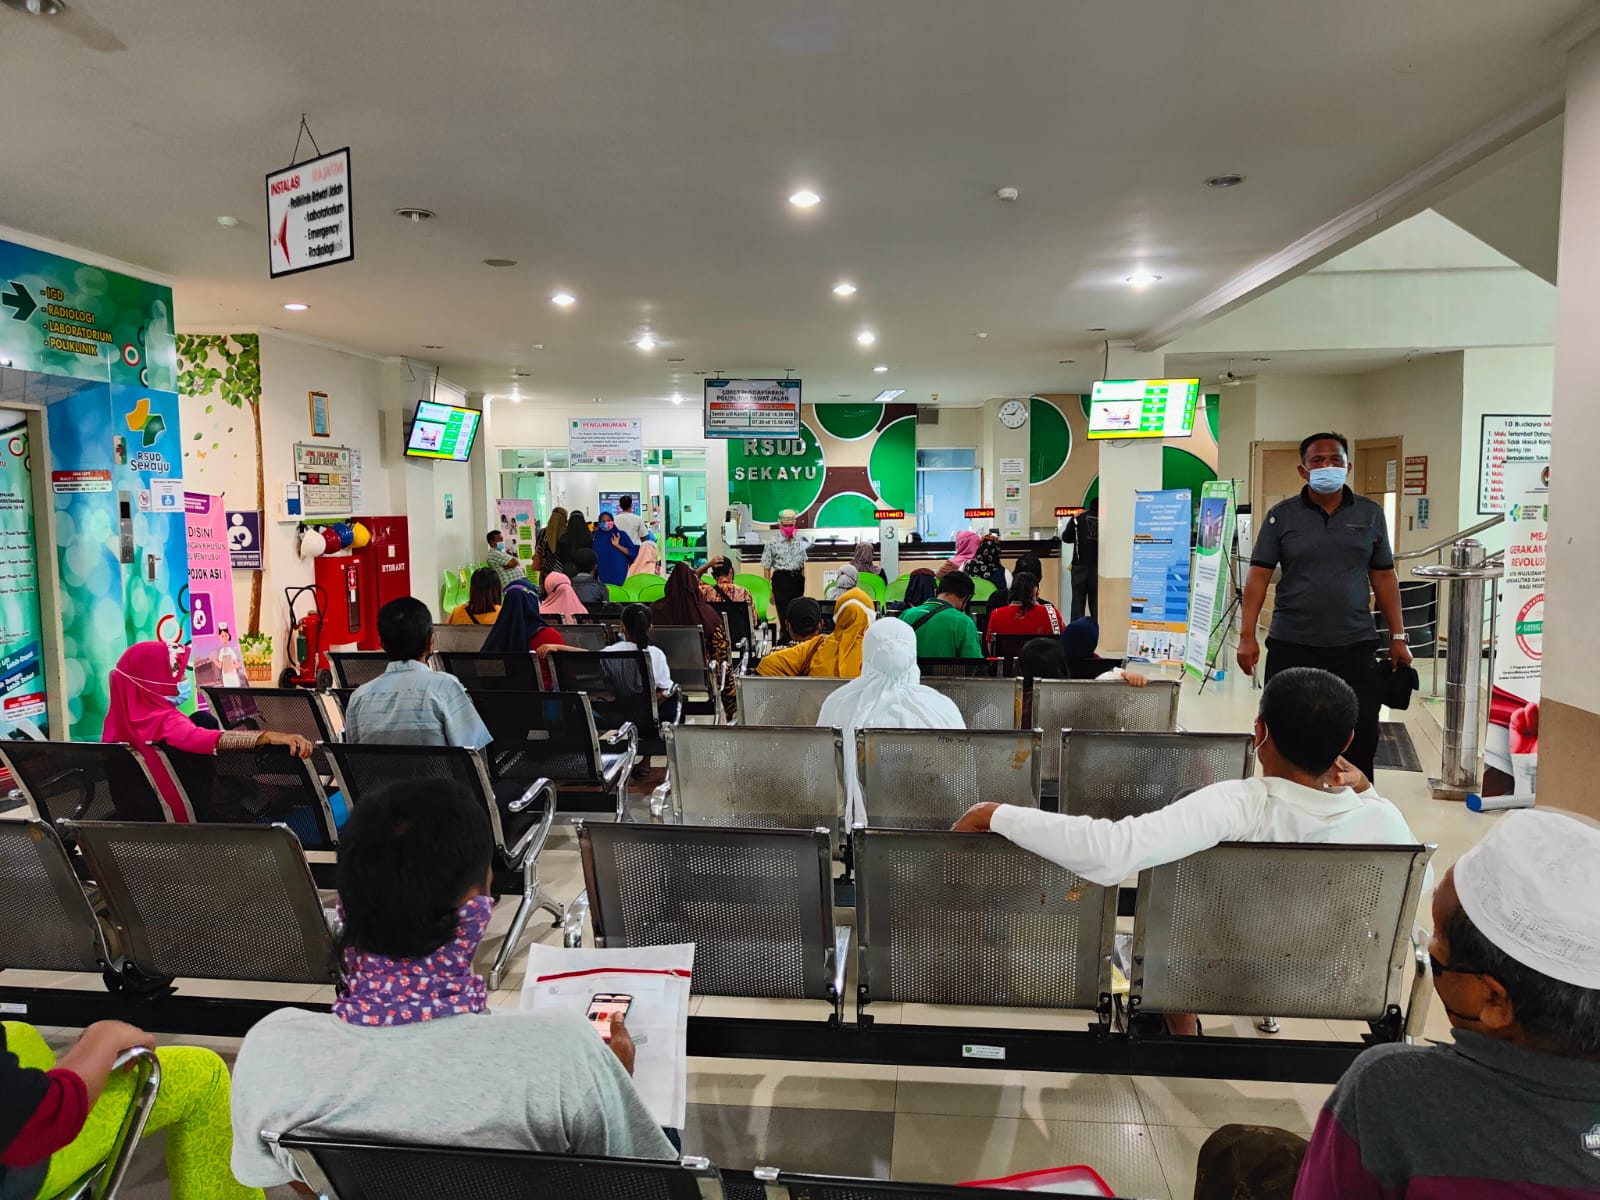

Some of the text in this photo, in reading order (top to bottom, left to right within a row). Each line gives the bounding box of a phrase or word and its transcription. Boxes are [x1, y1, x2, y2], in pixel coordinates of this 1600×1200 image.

[271, 175, 300, 196] INSTALASI
[307, 203, 344, 222] Laboratorium
[308, 224, 339, 240] Emergency
[46, 287, 64, 301] IGD
[48, 304, 95, 323] RADIOLOGI
[49, 321, 113, 342] LABORATORIUM
[50, 337, 97, 356] POLIKLINIK
[744, 439, 806, 455] RSUD
[137, 452, 161, 461] RSUD
[131, 460, 169, 474] Sekayu
[735, 466, 816, 480] SEKAYU
[188, 527, 213, 538] DISINI
[885, 526, 894, 539] 3
[1510, 545, 1543, 554] GERAKAN
[381, 563, 405, 572] HYDRANT
[1512, 558, 1545, 567] REVOLUSI
[188, 569, 208, 579] POJOK
[210, 569, 221, 579] ASI
